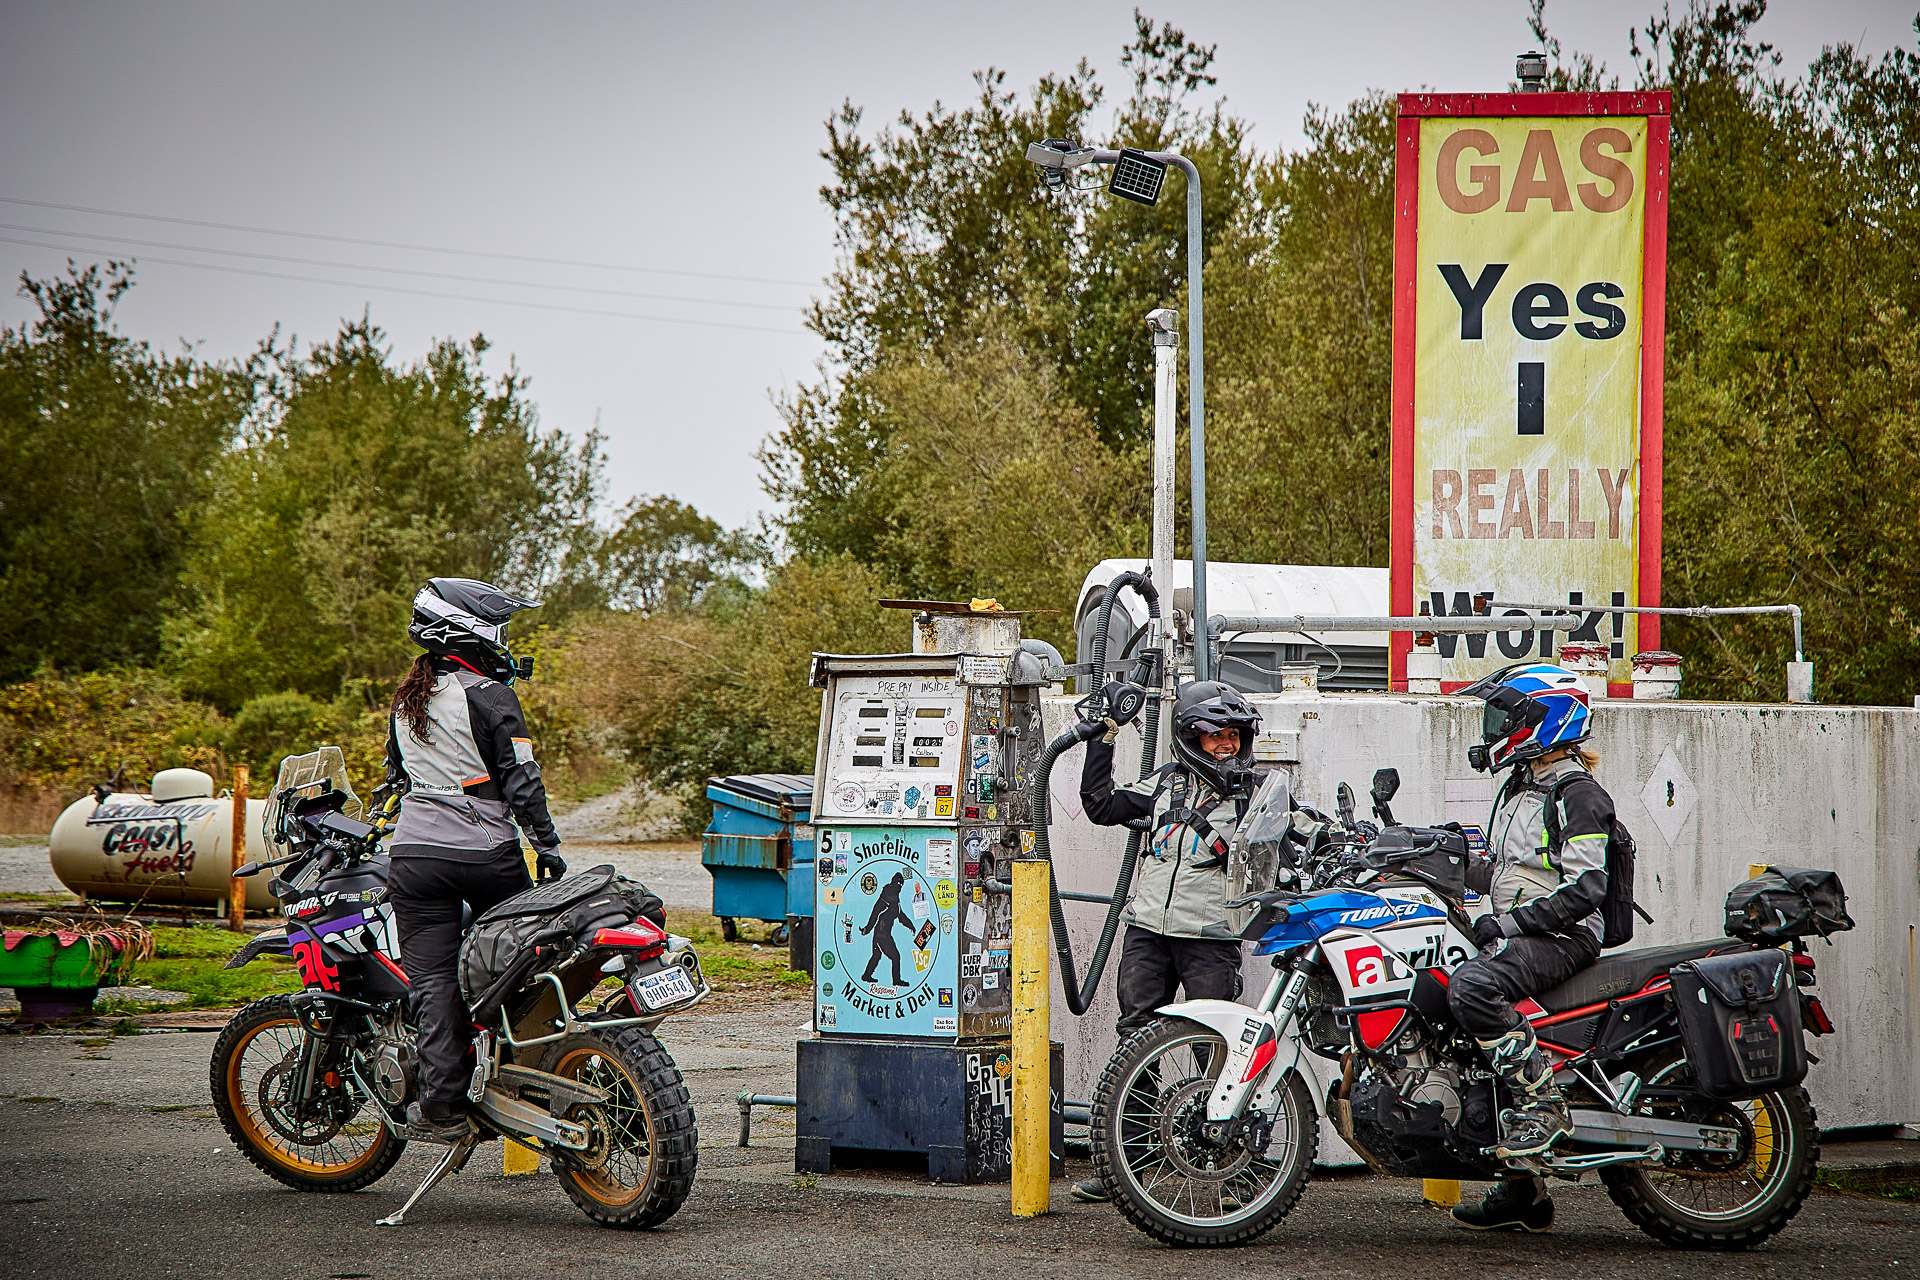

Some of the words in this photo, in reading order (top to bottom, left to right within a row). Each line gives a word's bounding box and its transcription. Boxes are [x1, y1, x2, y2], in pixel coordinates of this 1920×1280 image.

[1436, 127, 1635, 215] GAS
[1436, 263, 1627, 341] Yes
[1517, 361, 1545, 435] I
[1432, 468, 1629, 540] REALLY
[1430, 591, 1626, 660] Work!
[921, 681, 950, 693] INSIDE
[412, 781, 460, 792] alpinestars
[967, 780, 976, 794] G
[939, 804, 949, 813] 87
[102, 823, 188, 856] COAST
[820, 830, 833, 854] 5
[853, 838, 920, 865] Shoreline
[1020, 831, 1034, 849] TSC
[118, 839, 196, 881] Fuels
[1339, 903, 1420, 925] TUAREG
[914, 950, 929, 969] TSC
[963, 965, 981, 977] DBK
[840, 980, 891, 1020] Market
[895, 1000, 906, 1019] &
[906, 983, 935, 1015] Deli
